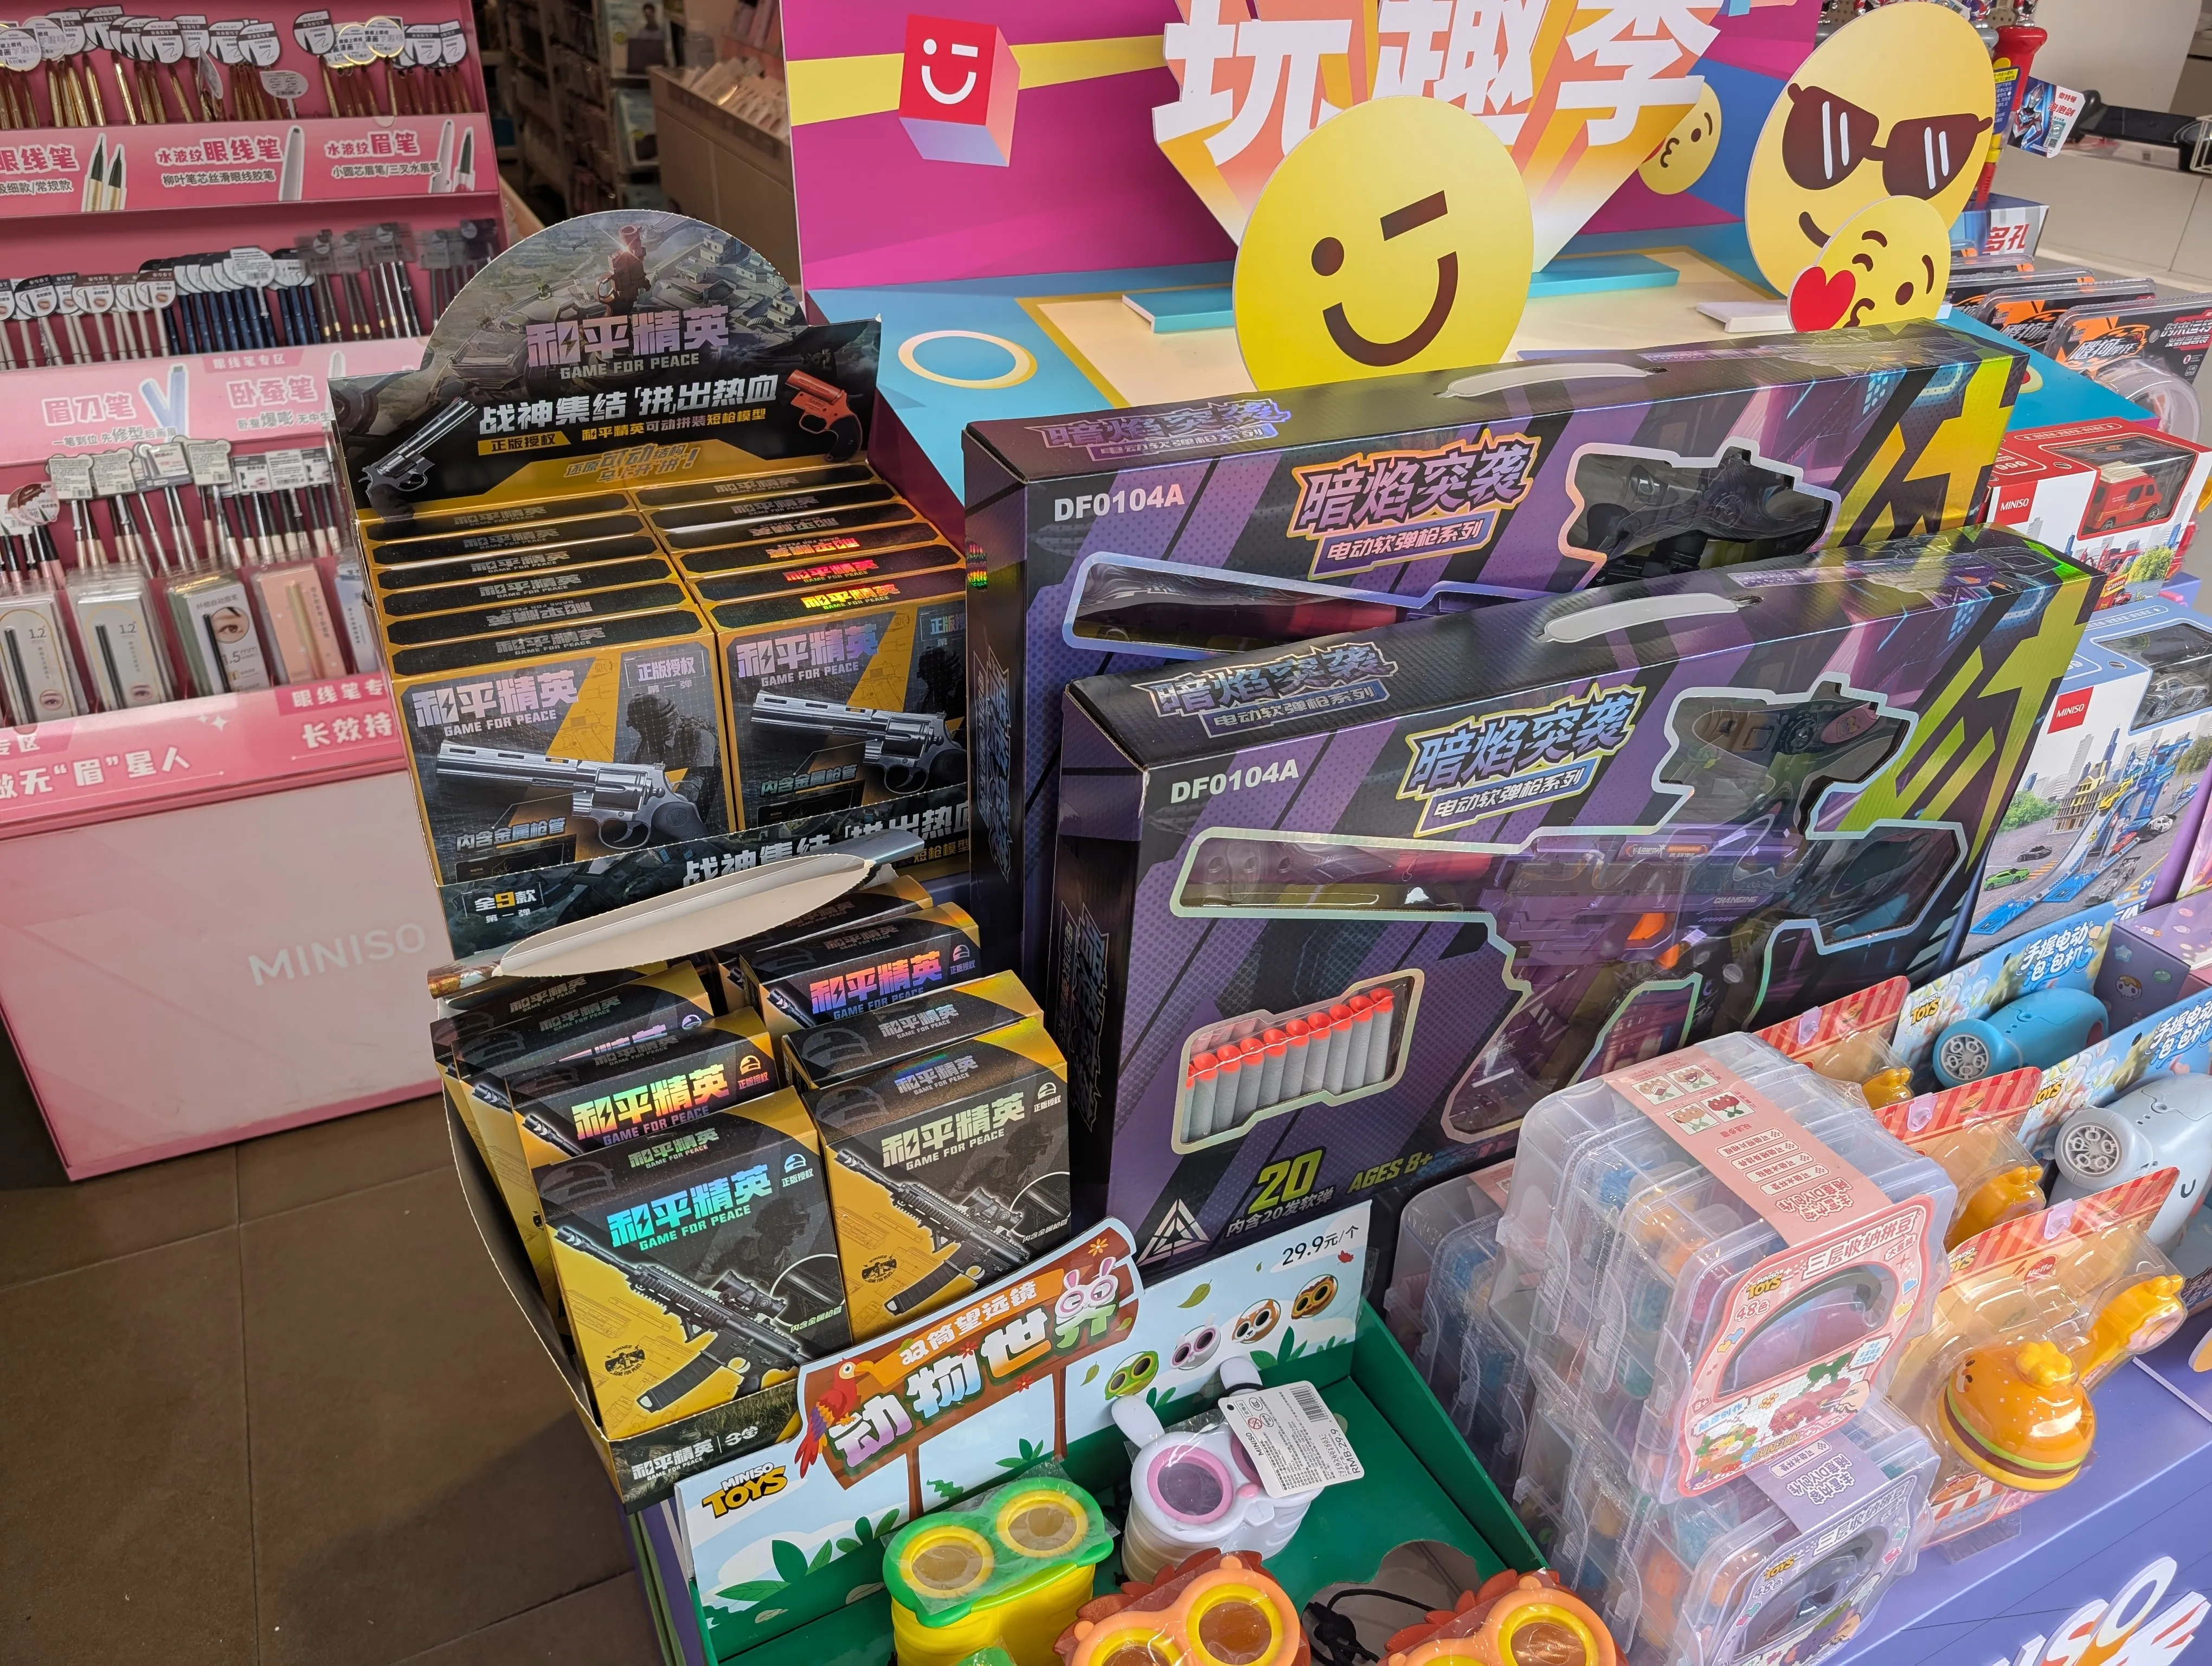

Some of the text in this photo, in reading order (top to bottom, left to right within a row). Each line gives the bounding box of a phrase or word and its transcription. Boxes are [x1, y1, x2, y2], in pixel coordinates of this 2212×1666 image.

[2059, 92, 2078, 103] 奥特曼
[157, 137, 283, 165] 水波纹眼线笔
[327, 132, 419, 157] 水波纹眉笔
[162, 170, 275, 185] 柳叶笔芯丝滑眼线胶笔
[332, 163, 441, 178] 小圆芯眉笔/三叉水眉笔
[1983, 224, 2030, 254] 多孔
[526, 305, 729, 367] 和平精英
[213, 356, 286, 369] 眼线笔专区
[560, 353, 699, 380] GAME FOR PEACE
[228, 377, 317, 408] 卧蚕笔
[43, 395, 136, 425] 眉刀笔
[297, 413, 336, 426] 无中生
[582, 408, 766, 440] 和平精英可动拼装短枪模型
[1046, 402, 1280, 447] 暗焰突袭
[492, 433, 556, 452] 正版授权
[1101, 427, 1265, 455] 电动软弹枪系列
[715, 477, 800, 493] 和平精英
[1300, 439, 1530, 528] 暗焰突袭
[454, 507, 546, 524] 和平精英
[731, 497, 819, 514] 和平精英
[1054, 483, 1185, 522] DF0104A
[2000, 498, 2029, 511] MINISO
[462, 528, 559, 548] 和平精英
[766, 538, 860, 558] 和平精英
[1327, 520, 1483, 561] 电动软弹枪系列
[471, 550, 570, 572] 和平精英
[783, 560, 878, 581] 和平精英
[479, 574, 582, 596] 和平精英
[801, 584, 900, 608] 和平精英
[496, 627, 606, 653] 和平精英
[737, 624, 878, 678] 和平精英
[638, 657, 696, 682] 正版授权
[761, 661, 859, 687] GAME FOR PEACE
[1148, 646, 1384, 713] 暗焰突袭
[292, 680, 383, 705] 眼线笔专
[413, 669, 578, 727] 和平精英
[648, 680, 692, 694] 第一弹
[1214, 685, 1376, 727] 电动软弹枪系列
[2056, 703, 2085, 719] MINISO
[303, 714, 393, 749] 长效持
[445, 709, 556, 737] GAME FOR PEACE
[1410, 694, 1635, 791] 暗焰突袭
[761, 763, 858, 797] 内含金属枪管
[1171, 759, 1299, 804] DF0104A
[1435, 766, 1586, 817] 电动软弹枪系列
[456, 817, 565, 850] 内含金属枪管
[475, 889, 537, 912] 全9款
[1713, 896, 1758, 905] CHANGING
[486, 908, 531, 923] 第一弹
[824, 924, 898, 950] 和平精英
[2020, 921, 2090, 971] 手握电动
[248, 924, 426, 986] MINISO
[950, 959, 976, 975] 正版授权
[810, 951, 942, 1014] 和平精英
[539, 996, 621, 1031] 和平精英
[833, 987, 925, 1020] GAME FOR PEACE
[1911, 997, 1940, 1025] TOYS
[1916, 994, 1938, 1007] MINISO
[879, 1003, 959, 1037] 和平精英
[593, 1035, 678, 1066] 和平精英
[738, 1071, 769, 1090] 正版授权
[895, 1055, 979, 1094] 和平精英
[571, 1064, 729, 1139] 和平精英
[1033, 1095, 1062, 1113] 正版授权
[2033, 1080, 2062, 1105] TOYS
[602, 1105, 710, 1145] GAME FOR PEACE
[881, 1092, 1025, 1168] 和平精英
[628, 1127, 719, 1169] 和平精英
[906, 1128, 1005, 1170] GAME FOR PEACE
[781, 1169, 813, 1187] 正版授权
[1248, 1149, 1323, 1214] 20
[1348, 1152, 1433, 1193] AGES 8+
[606, 1164, 773, 1248] 和平精英
[1777, 1178, 1853, 1212] 随意DIY创作
[1801, 1193, 1853, 1221] 丰富内容
[1226, 1188, 1334, 1236] 内含20发软弹
[639, 1204, 751, 1251] GAME FOR PEACE
[1023, 1218, 1069, 1242] 内含金属枪管
[1282, 1225, 1360, 1266] 29.9元/个
[1804, 1213, 1916, 1277] 三层收纳拼豆
[1756, 1272, 1780, 1285] MINISO
[2026, 1261, 2054, 1280] Hello
[1747, 1276, 1782, 1300] TOYS
[790, 1305, 842, 1334] 内含金属枪管
[899, 1281, 1038, 1366] 双筒望远镜
[1735, 1301, 1770, 1321] 48色
[1694, 1399, 1708, 1410] 8+
[1245, 1431, 1264, 1456] MINISO
[1330, 1426, 1360, 1474] RMB:29.9
[633, 1440, 713, 1480] 和平精英
[647, 1457, 703, 1481] GAME FOR PEACE
[721, 1463, 774, 1490] MINISO
[1787, 1454, 1853, 1496] 随意DIY创作
[1809, 1470, 1856, 1505] 丰富内容
[702, 1465, 787, 1518] TOYS
[1763, 1556, 1795, 1580] TOYS
[1753, 1578, 1783, 1599] 48色
